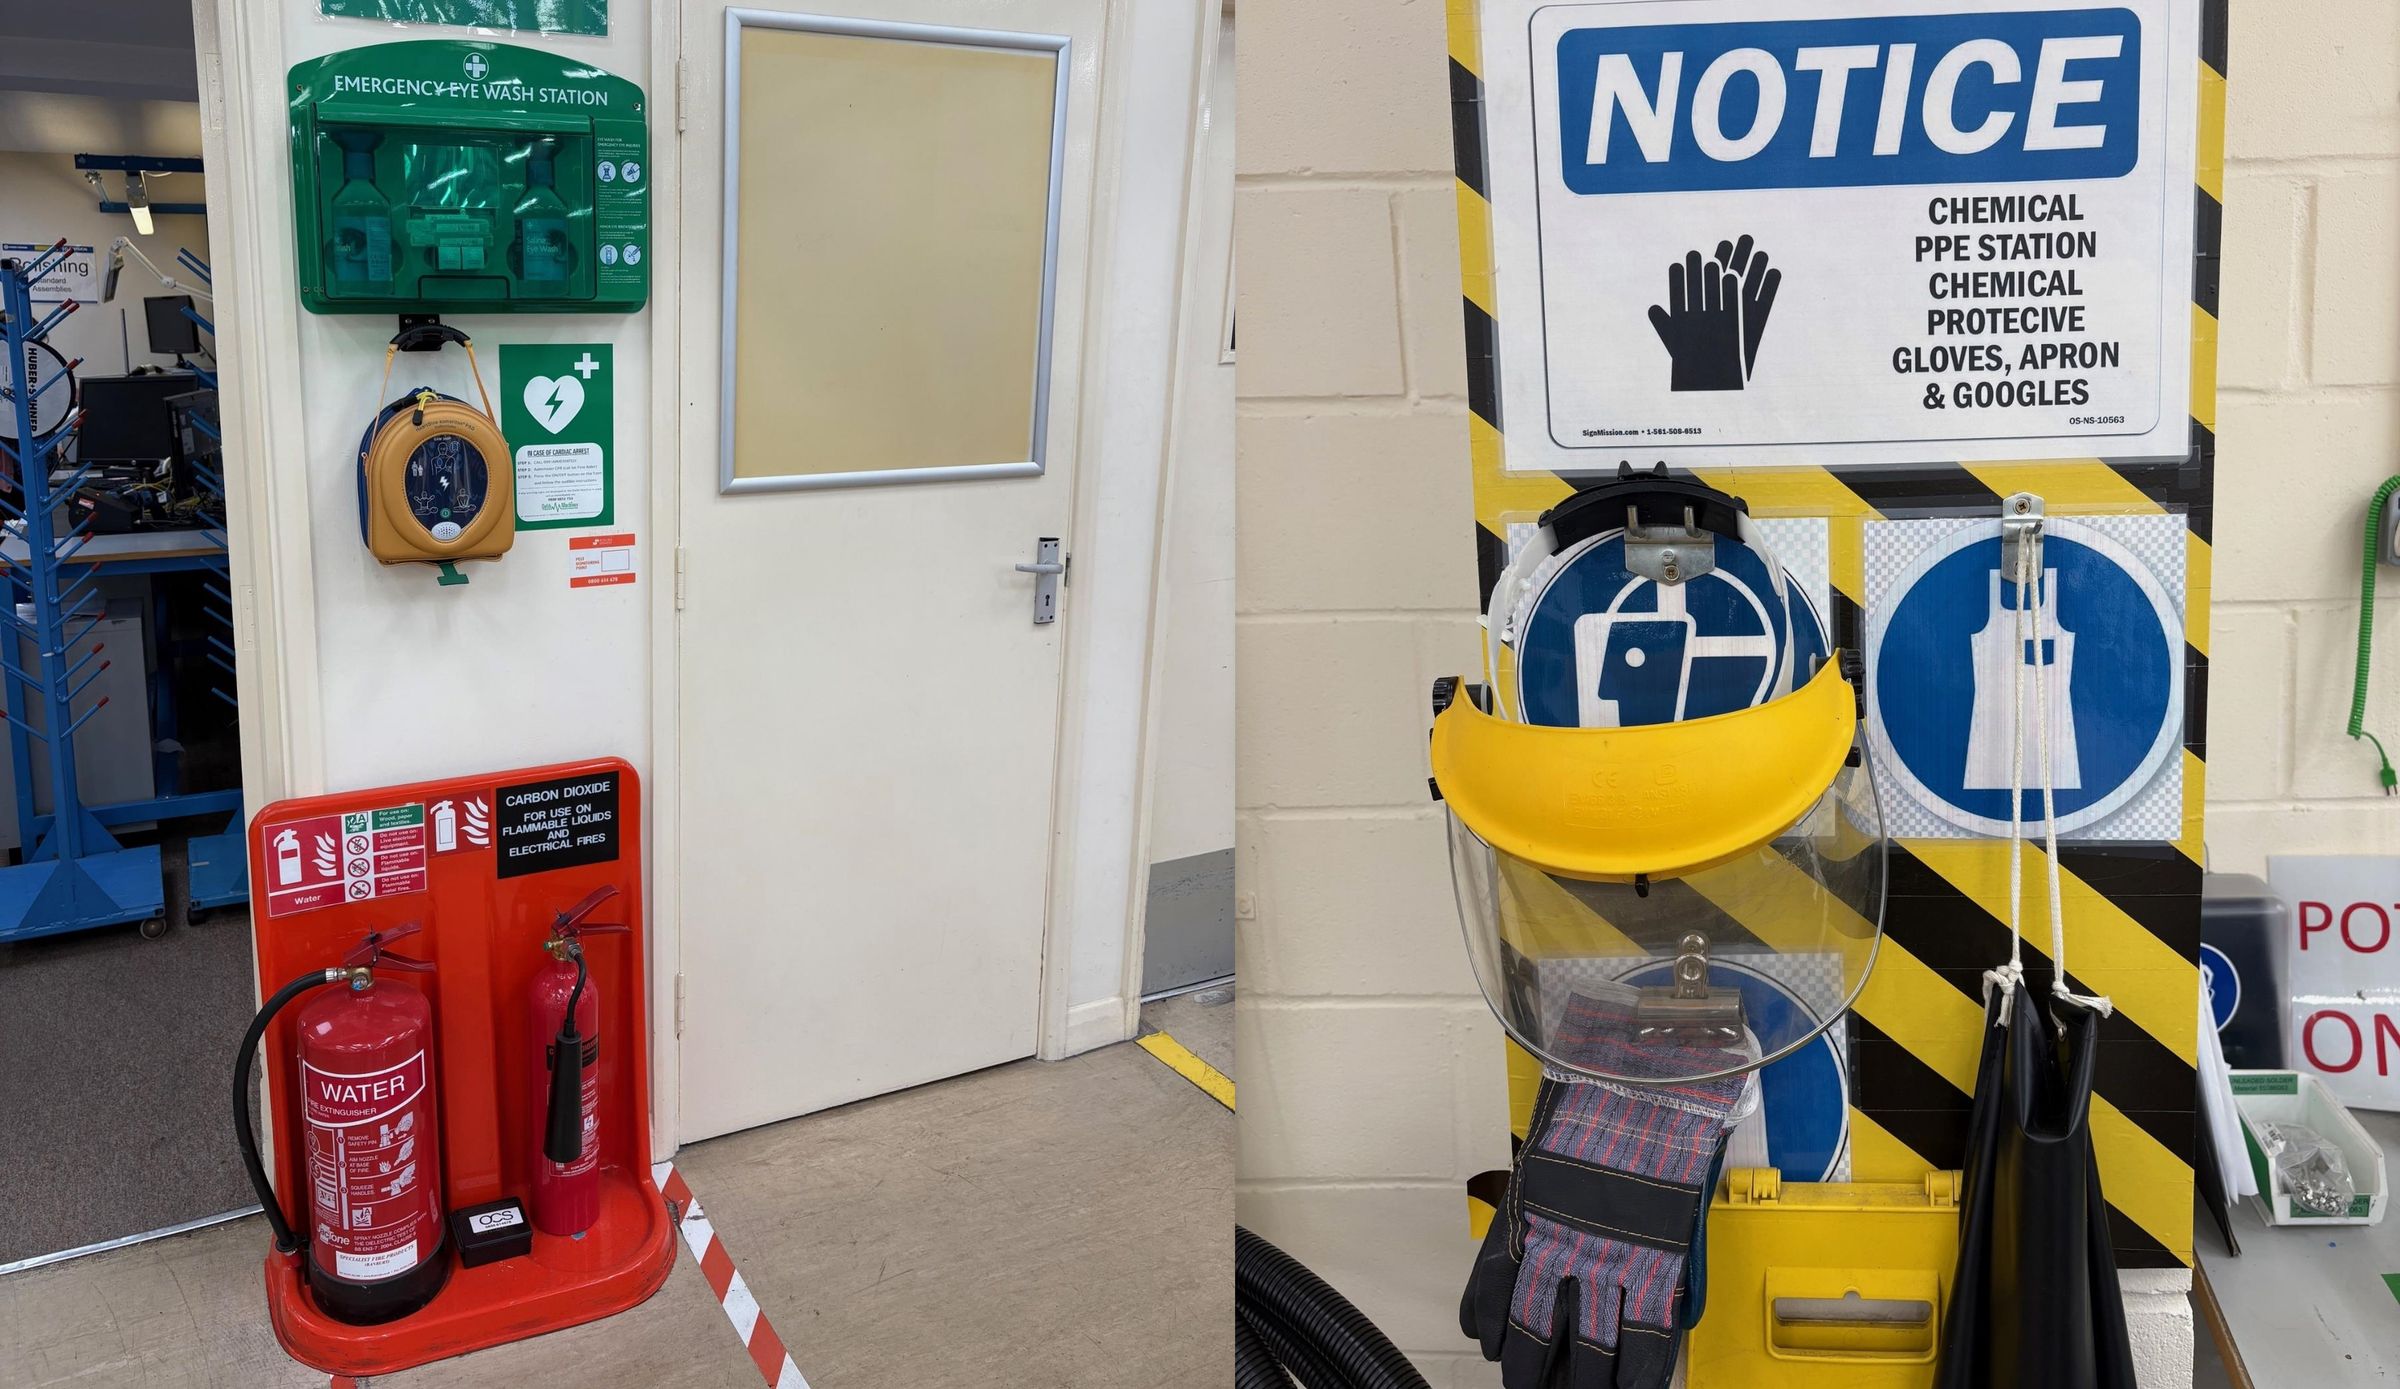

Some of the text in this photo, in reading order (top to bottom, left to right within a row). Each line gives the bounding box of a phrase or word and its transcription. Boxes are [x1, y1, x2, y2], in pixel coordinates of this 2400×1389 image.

[335, 76, 608, 106] EMERGENCY EYE WASH STATION
[1586, 34, 2124, 165] NOTICE
[1928, 194, 2084, 225] CHEMICAL
[1915, 231, 2096, 262] PPE STATION
[1929, 269, 2083, 300] CHEMICAL
[1927, 306, 2085, 336] PROTECIVE
[1892, 341, 2119, 376] GLOVES, APRON
[1923, 379, 2090, 410] & GOOGLES
[2069, 415, 2125, 425] OS-NS-10563
[1582, 428, 1639, 438] SignMission.com
[533, 449, 545, 457] CASE
[552, 448, 572, 456] CARDIAC
[572, 447, 590, 455] ARREST
[505, 781, 611, 807] CARBON DIOXIDE
[502, 811, 612, 837] FLAMMABLE LIQUIDS
[524, 803, 592, 822] FOR USE ON
[392, 834, 417, 842] electrical
[509, 833, 606, 857] ELECTRICAL FIRES
[547, 829, 570, 841] AND
[294, 895, 321, 905] Water
[2299, 901, 2400, 954] PO
[321, 1075, 405, 1103] WATER
[320, 1105, 377, 1117] EXTINGUISHER
[372, 1231, 393, 1240] NOZZLE
[393, 1219, 417, 1234] COMPLIES
[479, 1210, 514, 1226] OCS
[365, 1235, 396, 1246] DIELECTRIC
[340, 1254, 371, 1262] SPECIALIST
[386, 1244, 414, 1259] PRODUCTS
